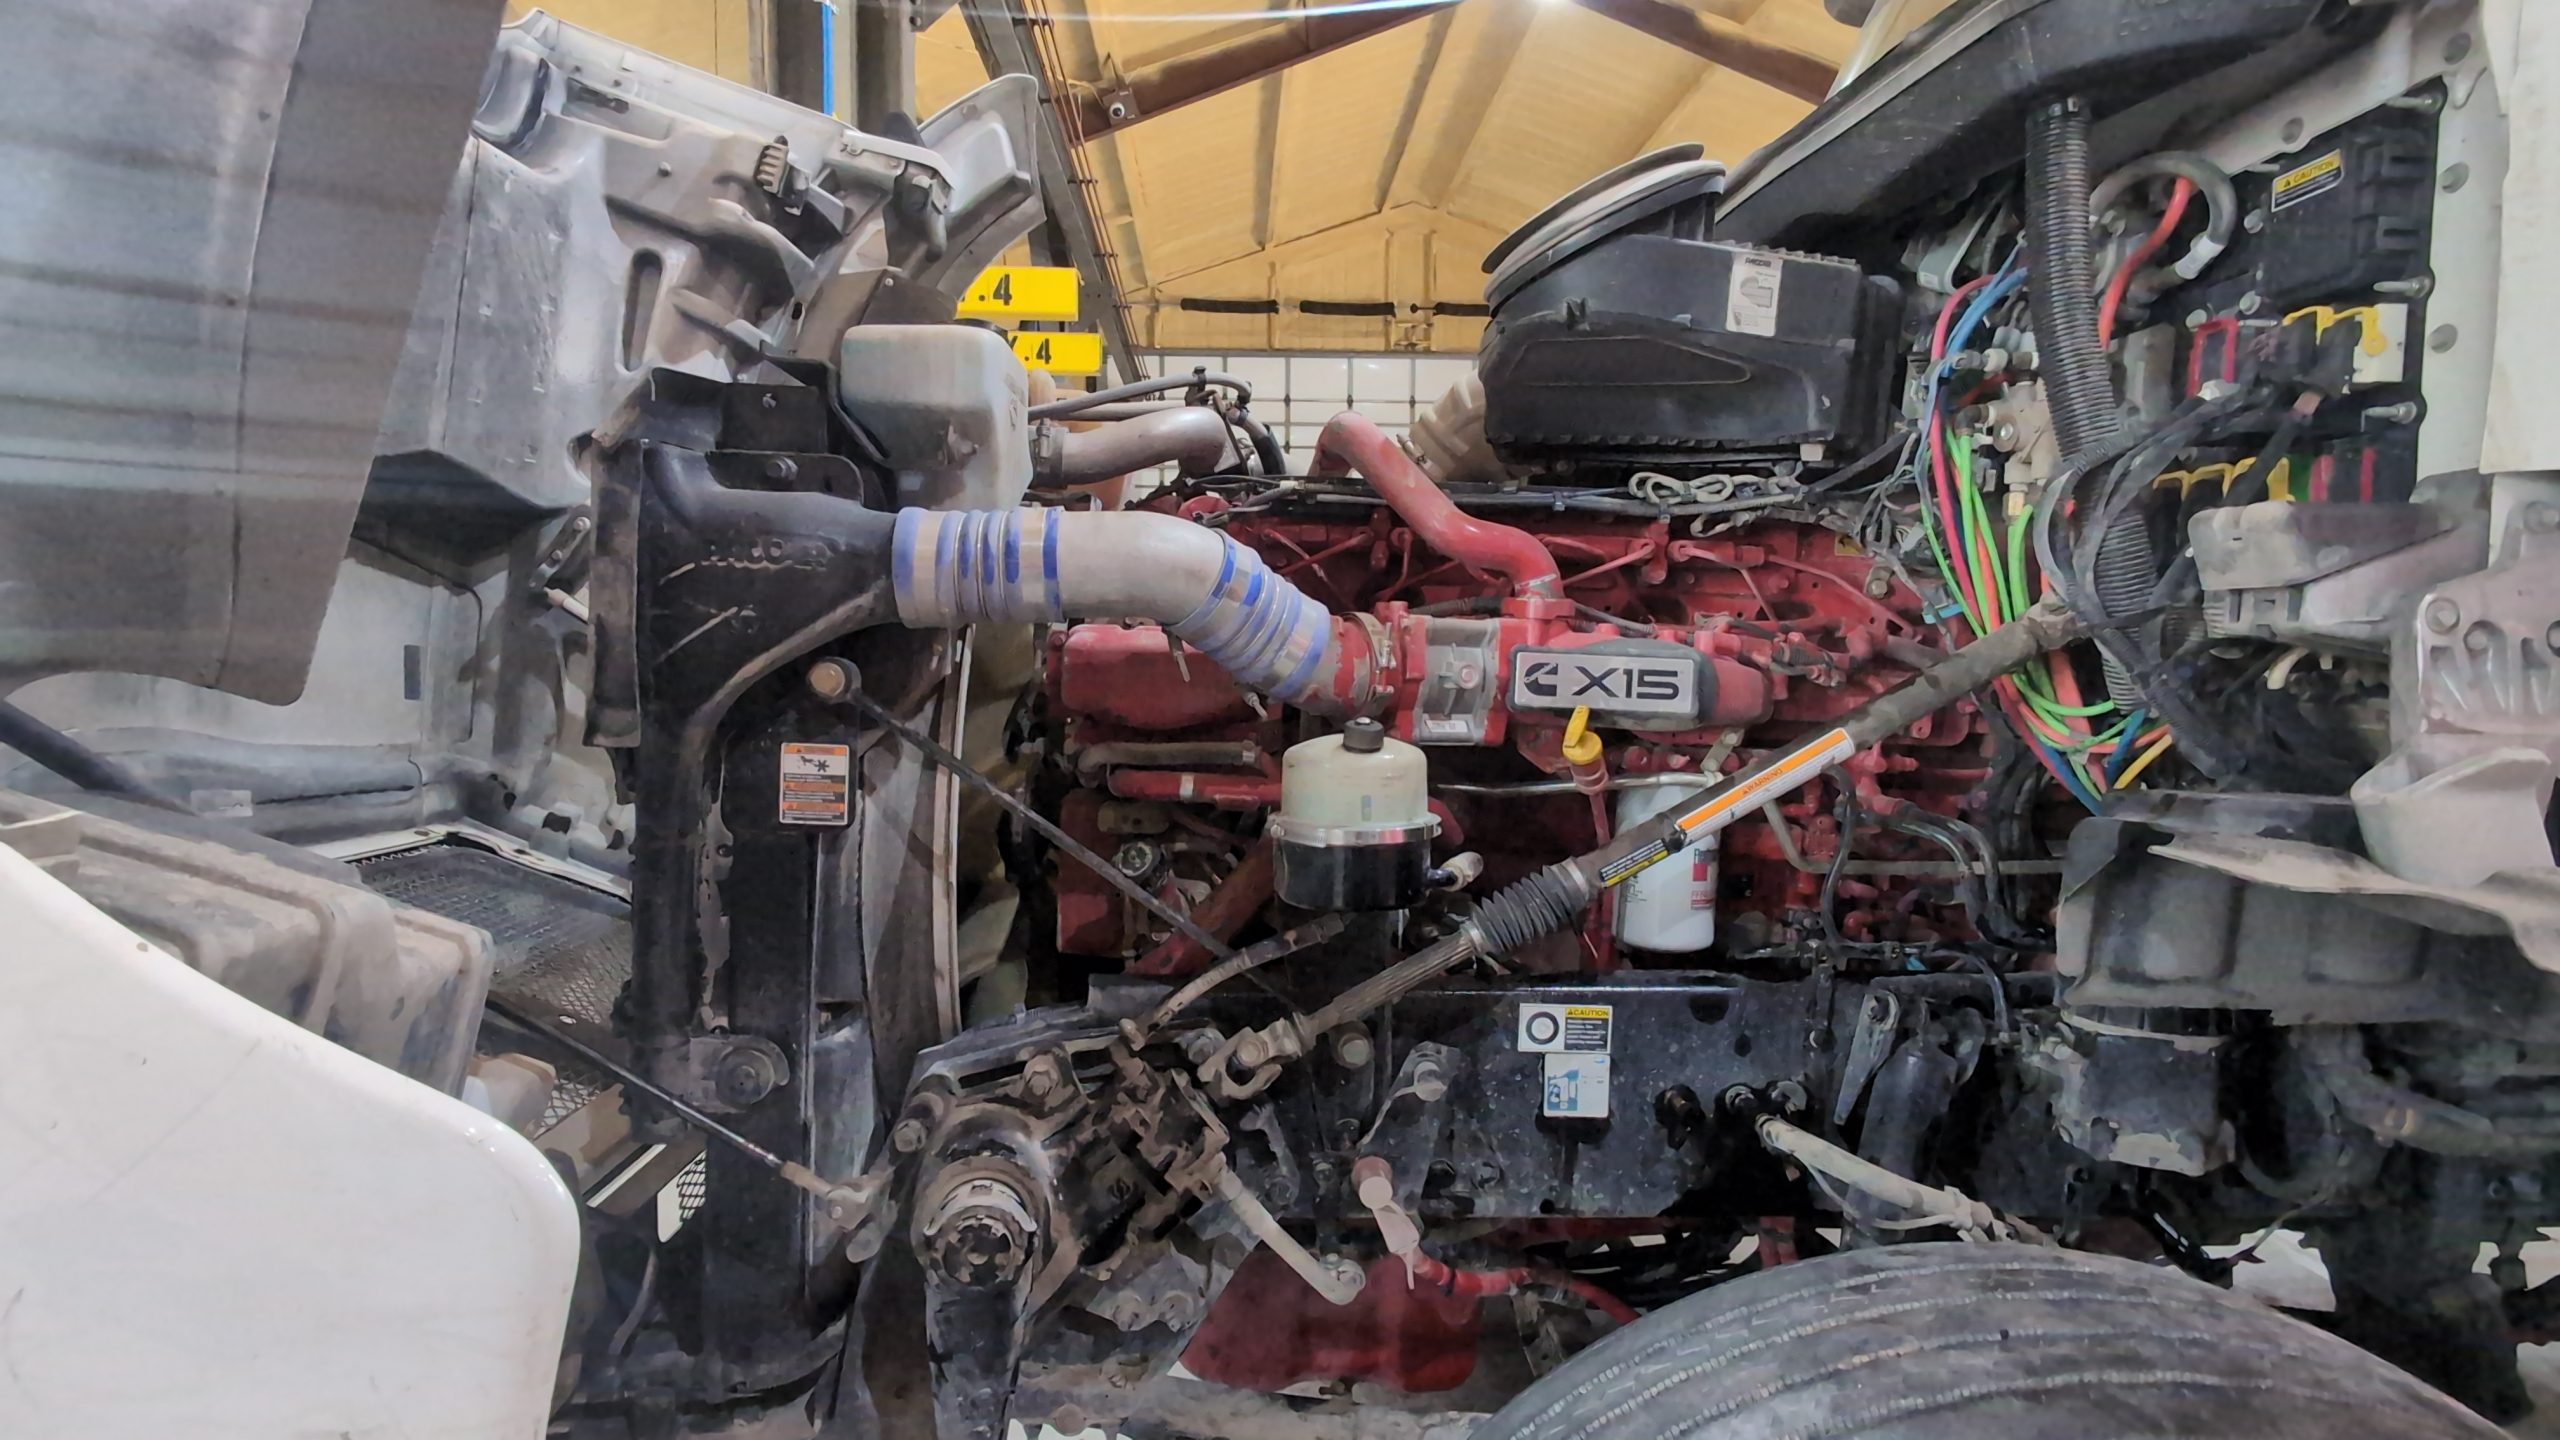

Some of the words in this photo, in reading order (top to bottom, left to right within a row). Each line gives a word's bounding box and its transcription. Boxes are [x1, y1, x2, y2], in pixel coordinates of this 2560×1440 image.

[2293, 161, 2333, 182] CAUTION
[961, 273, 1012, 306] .4
[1571, 666, 1680, 700] X15
[1747, 768, 1783, 791] WARNING
[1573, 1008, 1609, 1017] CAUTION
